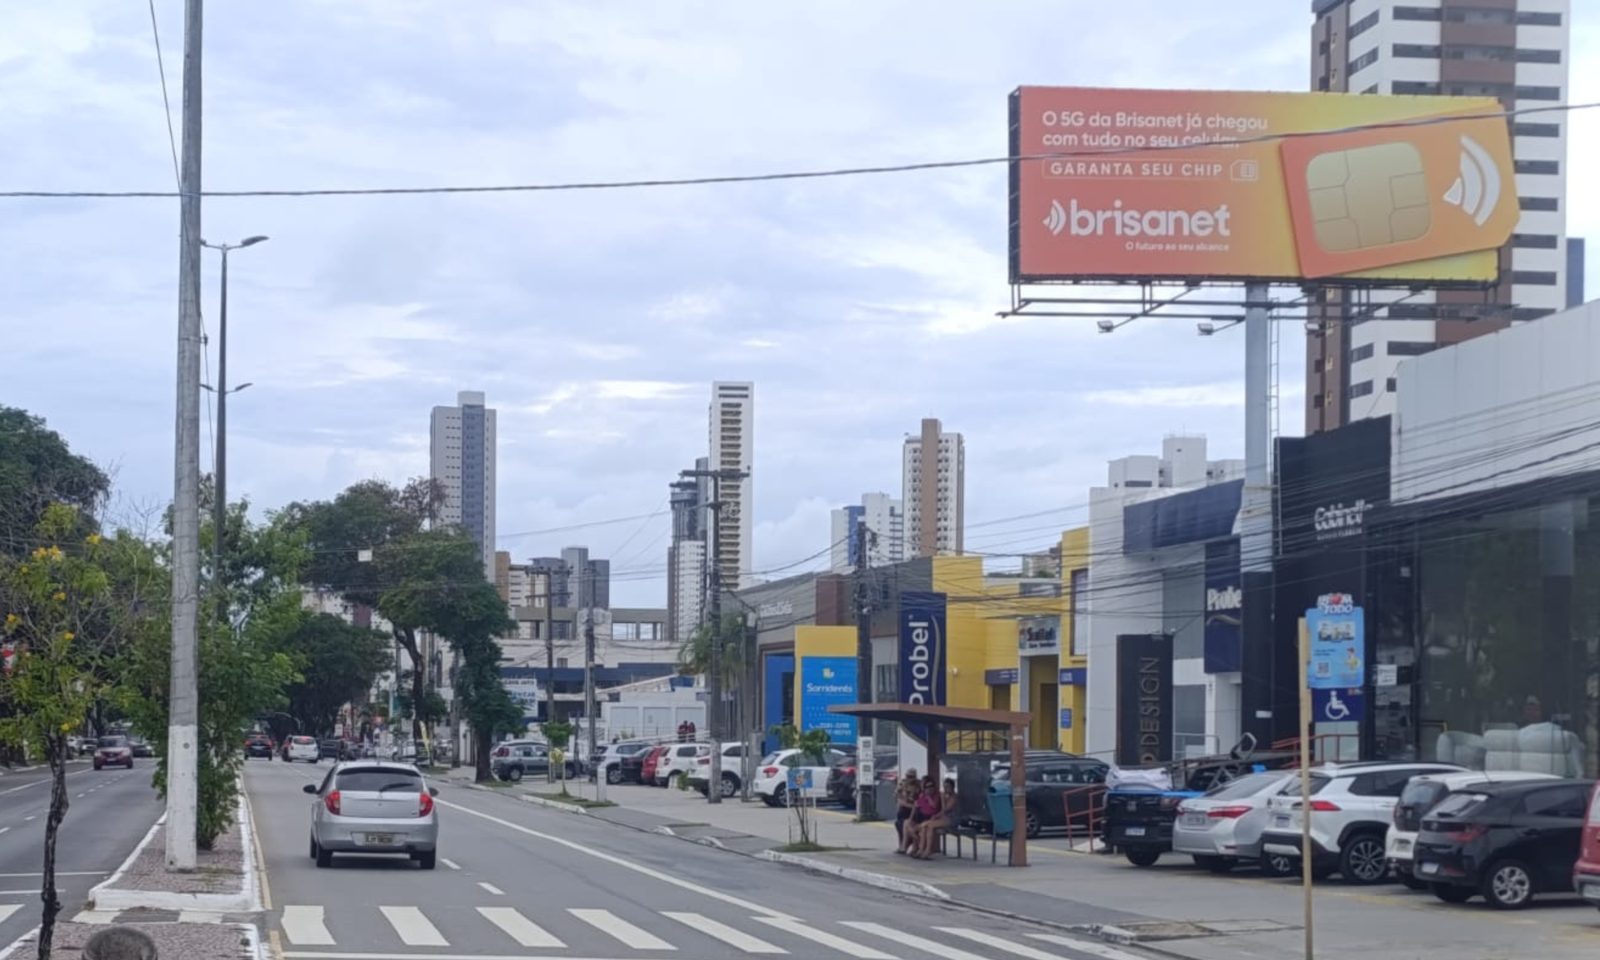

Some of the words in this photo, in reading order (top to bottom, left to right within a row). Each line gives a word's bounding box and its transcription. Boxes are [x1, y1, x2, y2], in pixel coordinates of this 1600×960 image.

[1042, 110, 1058, 126] O
[1060, 110, 1085, 127] 5G
[1088, 111, 1112, 127] da
[1115, 111, 1183, 128] Brisanet
[1184, 112, 1202, 132] já
[1205, 113, 1269, 133] chegou
[1042, 133, 1079, 147] com
[1081, 131, 1122, 147] tudo
[1124, 134, 1147, 147] no
[1149, 134, 1179, 148] seu
[1050, 161, 1134, 176] GARANTA
[1141, 162, 1174, 176] SEU
[1181, 162, 1223, 177] CHIP
[1070, 198, 1231, 236] brisanet
[1125, 241, 1135, 251] O
[1136, 241, 1164, 251] futuro
[1178, 243, 1195, 252] seu
[1196, 242, 1230, 252] alcance
[1140, 656, 1160, 746] DESIGN
